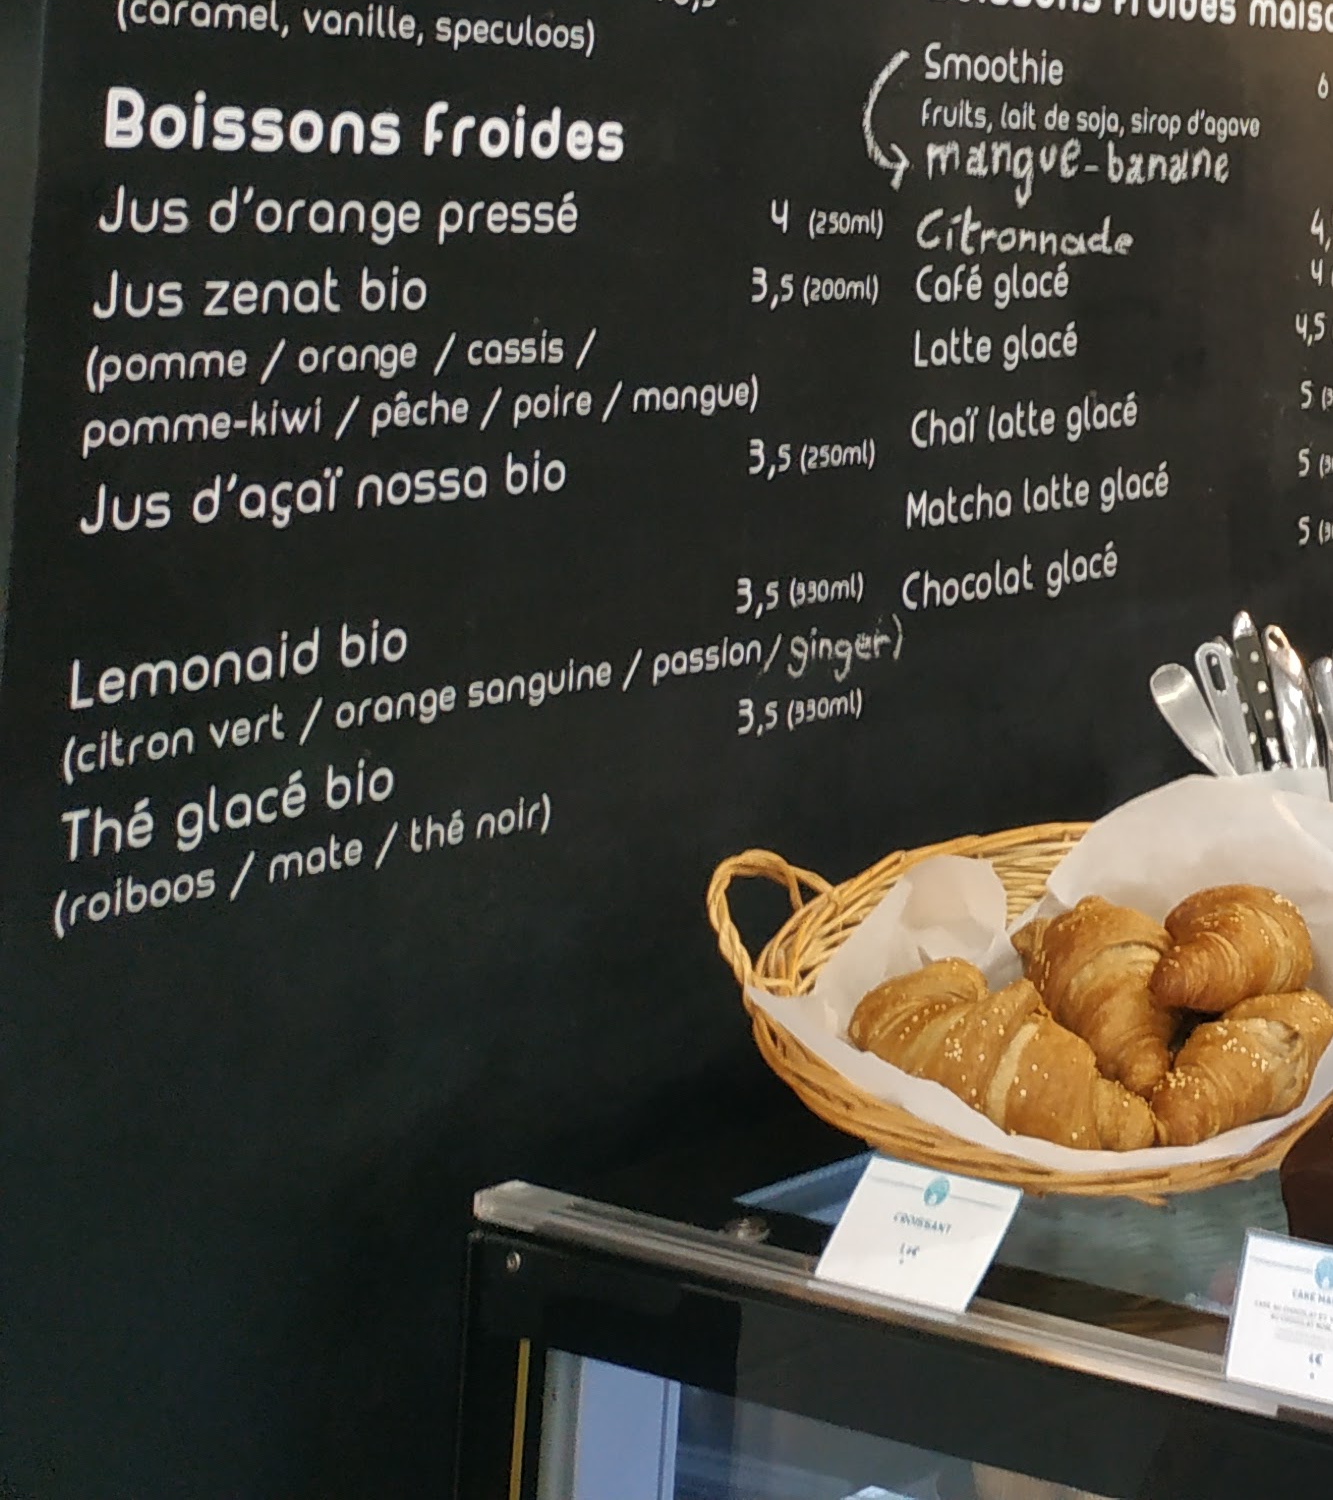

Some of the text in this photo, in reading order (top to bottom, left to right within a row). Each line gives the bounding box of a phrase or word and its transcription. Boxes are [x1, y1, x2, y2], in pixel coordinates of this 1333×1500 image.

[303, 3, 423, 46] vanille,
[436, 15, 595, 57] speculoos)
[925, 42, 1063, 85] Smoothie
[1317, 72, 1329, 99] 6
[105, 87, 624, 161] Boissons froides
[99, 185, 189, 233] Jus
[438, 191, 578, 245] pressé
[916, 205, 1134, 256] Citronnade
[93, 266, 427, 319] Jus zenat bio
[916, 261, 1069, 309] Café glacé
[906, 461, 1169, 529] Matcha latte glacé
[902, 541, 1118, 610] Chocolat glacé
[70, 619, 407, 710] Lemonaid bio
[61, 758, 394, 861] Thé glacé bio
